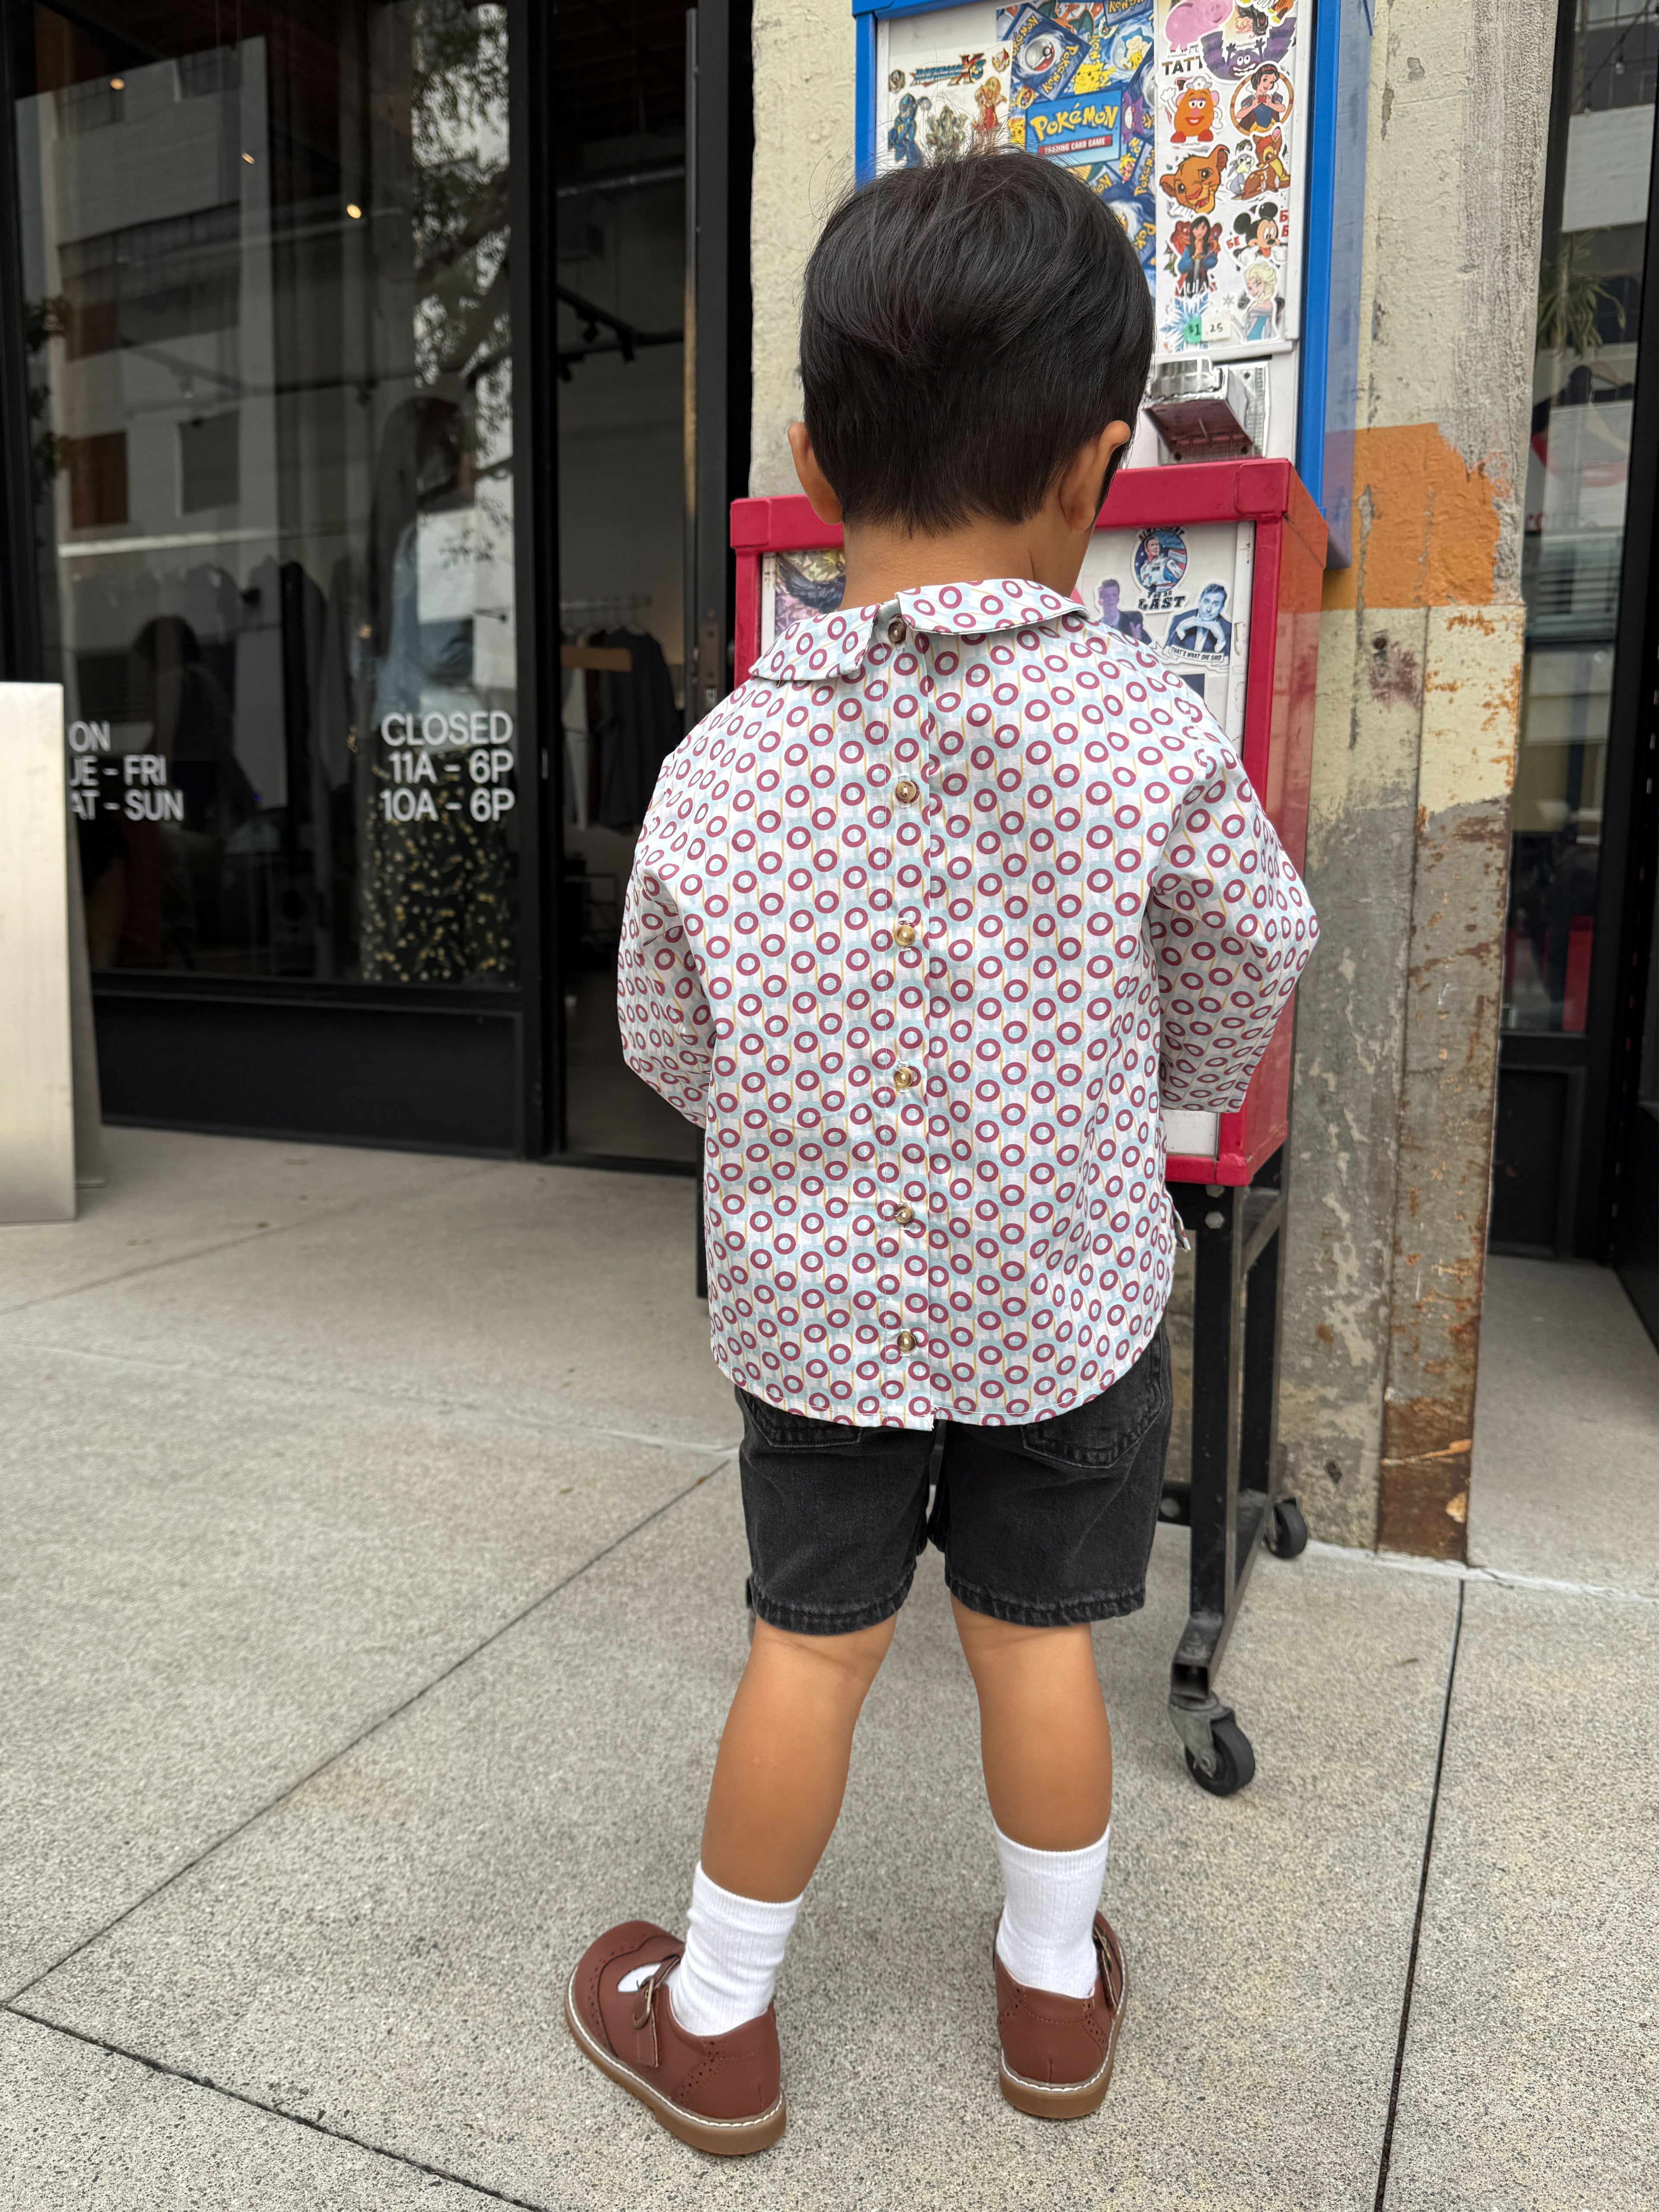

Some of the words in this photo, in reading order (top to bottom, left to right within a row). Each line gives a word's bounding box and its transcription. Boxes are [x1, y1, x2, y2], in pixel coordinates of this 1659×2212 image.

[1030, 103, 1119, 141] Pokémon
[1138, 596, 1185, 611] LAST
[68, 720, 111, 752] ON
[381, 710, 513, 747] CLOSED
[124, 754, 167, 786] FRI
[389, 750, 438, 784] 11A
[469, 748, 514, 784] 6P
[71, 789, 100, 821] AT
[124, 788, 184, 821] SUN
[379, 787, 439, 822] 10A
[470, 787, 515, 822] 6P
